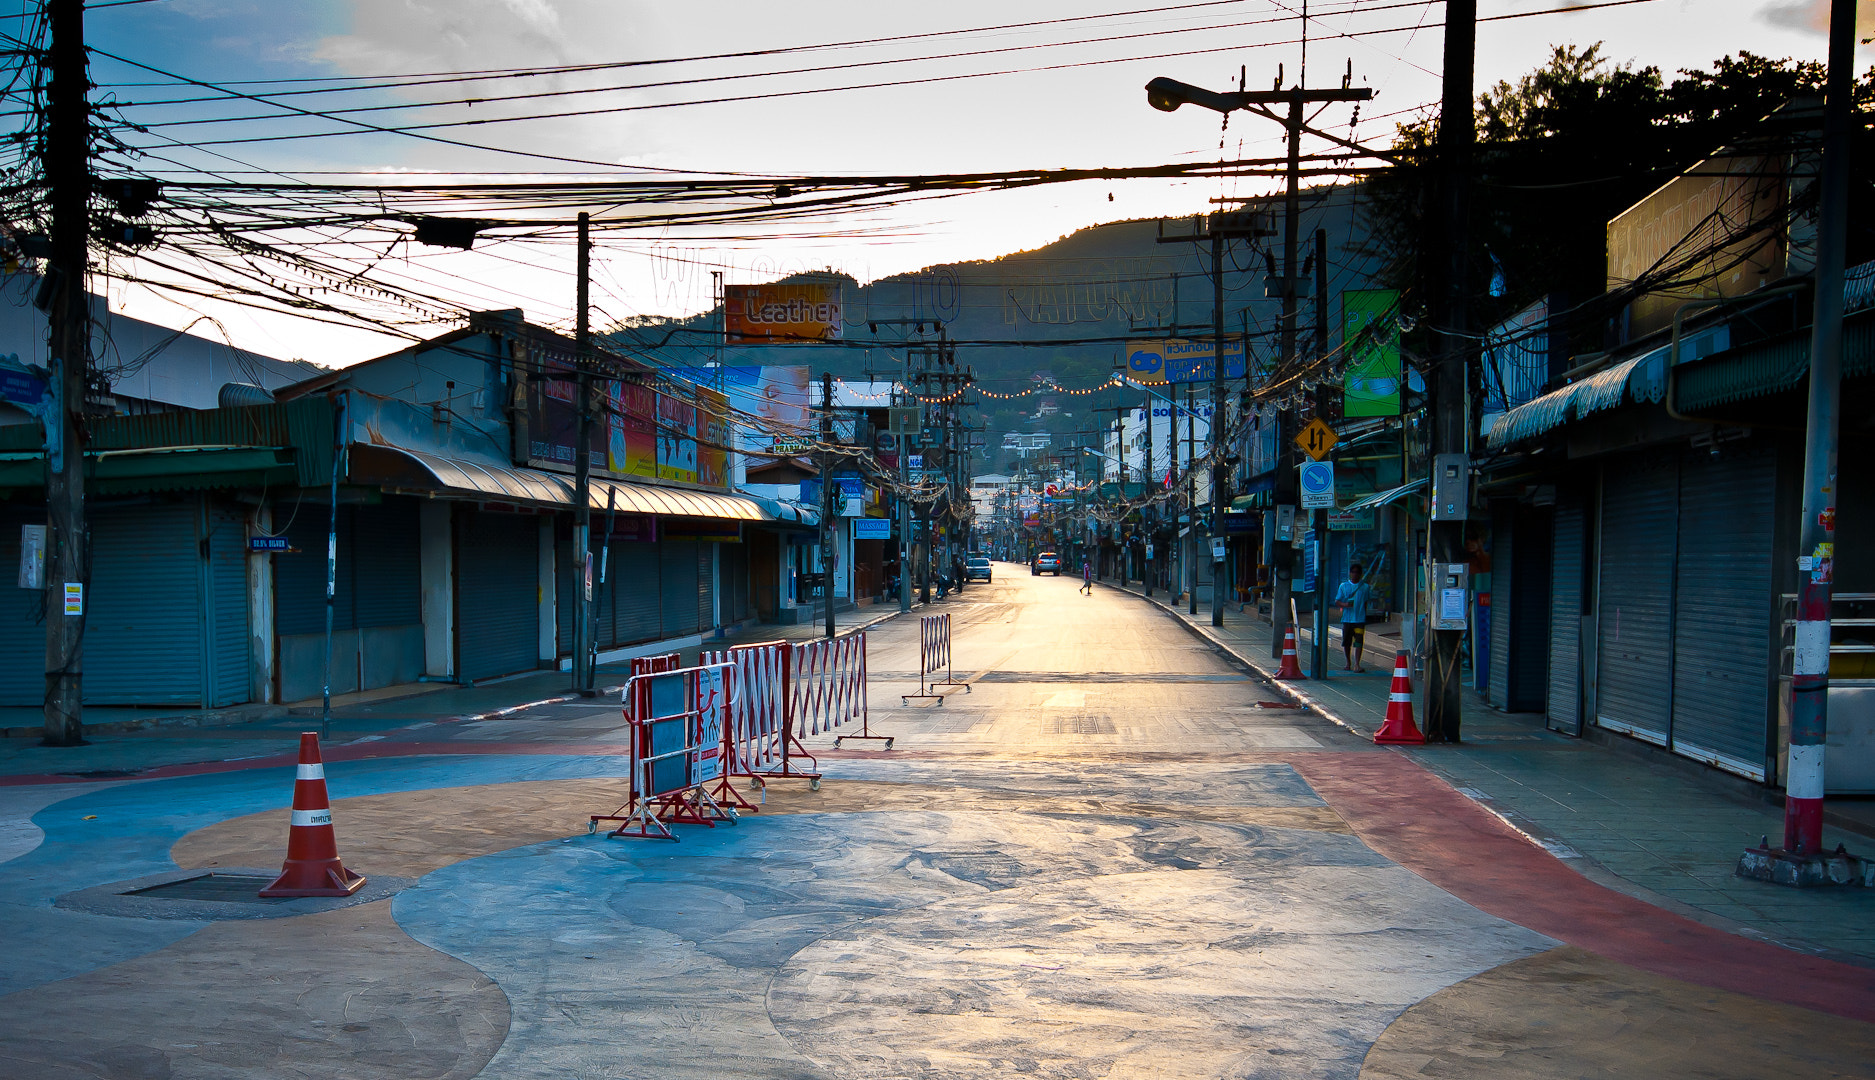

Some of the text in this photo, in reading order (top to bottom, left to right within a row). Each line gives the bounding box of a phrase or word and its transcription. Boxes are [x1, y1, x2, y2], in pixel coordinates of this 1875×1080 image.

[746, 298, 839, 324] Leather
[1168, 356, 1241, 371] TOP CHAEN
[1176, 367, 1232, 381] OPTICL
[858, 522, 888, 530] MASSAGE
[268, 539, 286, 548] SILVER
